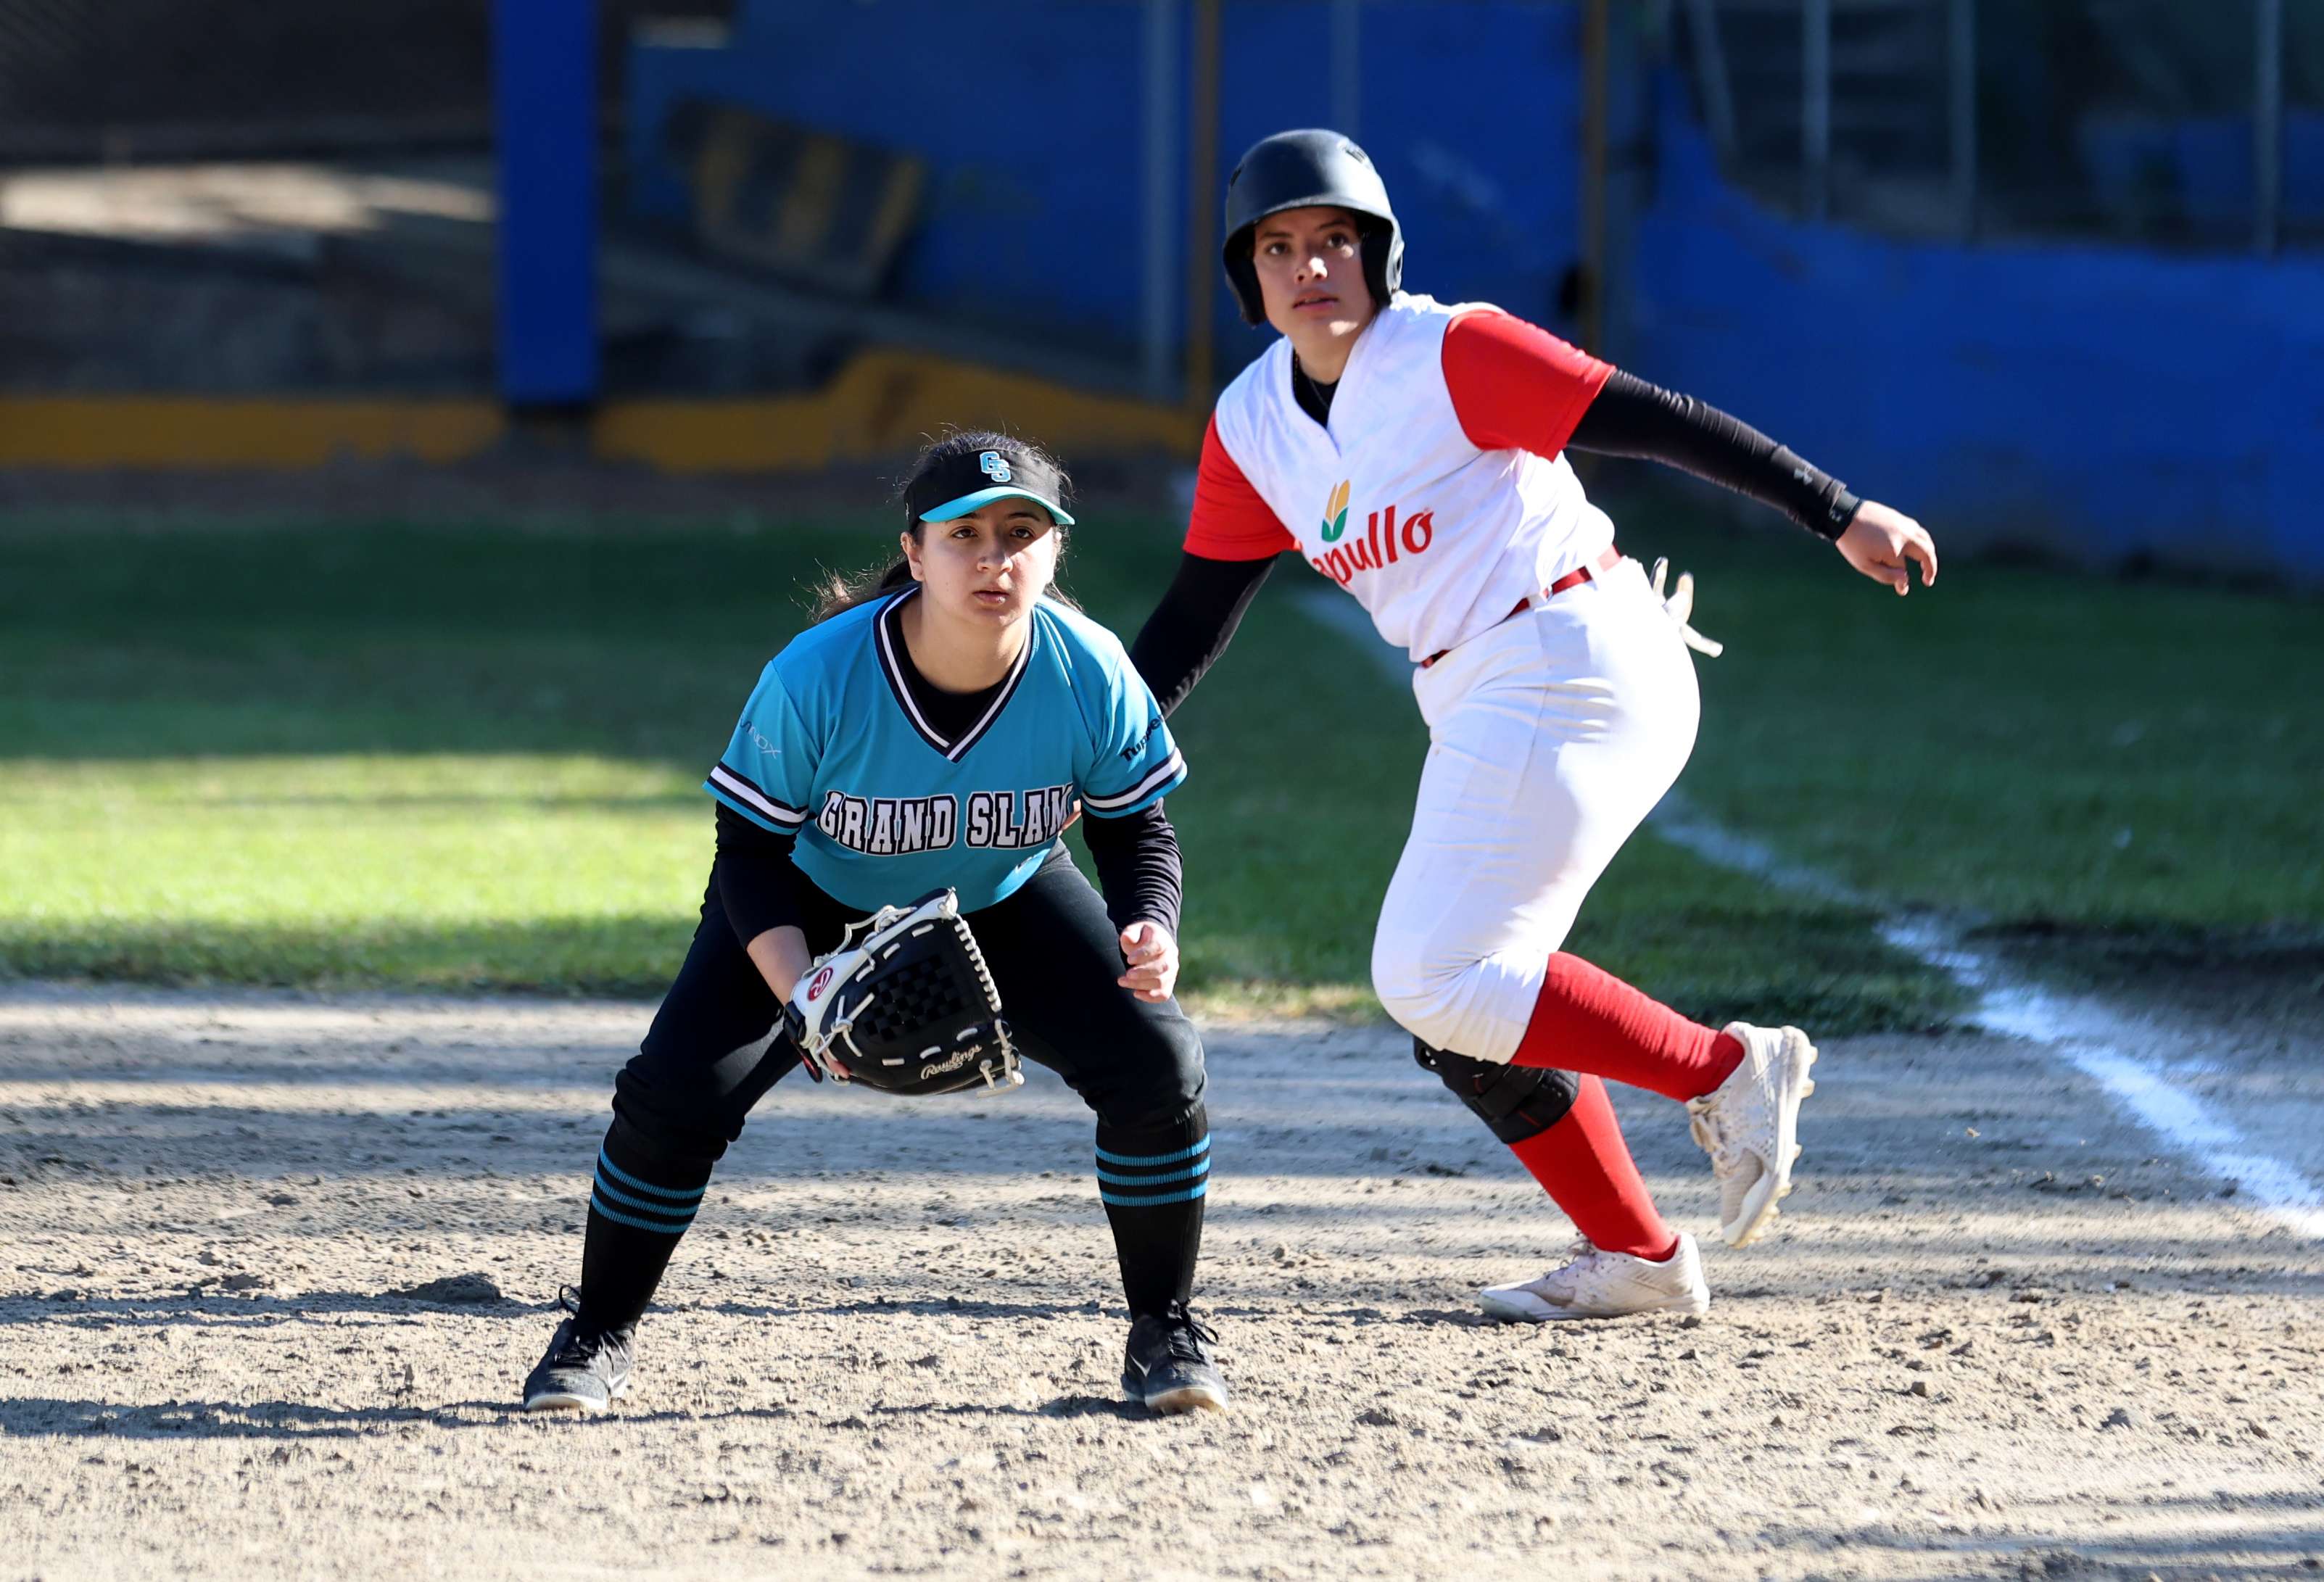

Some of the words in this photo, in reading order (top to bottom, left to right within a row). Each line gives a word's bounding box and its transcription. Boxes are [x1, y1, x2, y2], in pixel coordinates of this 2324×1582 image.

[980, 451, 1012, 482] GS
[816, 790, 958, 856] GRAND
[964, 783, 1074, 849] SLAM
[920, 1044, 982, 1080] Rawlings
